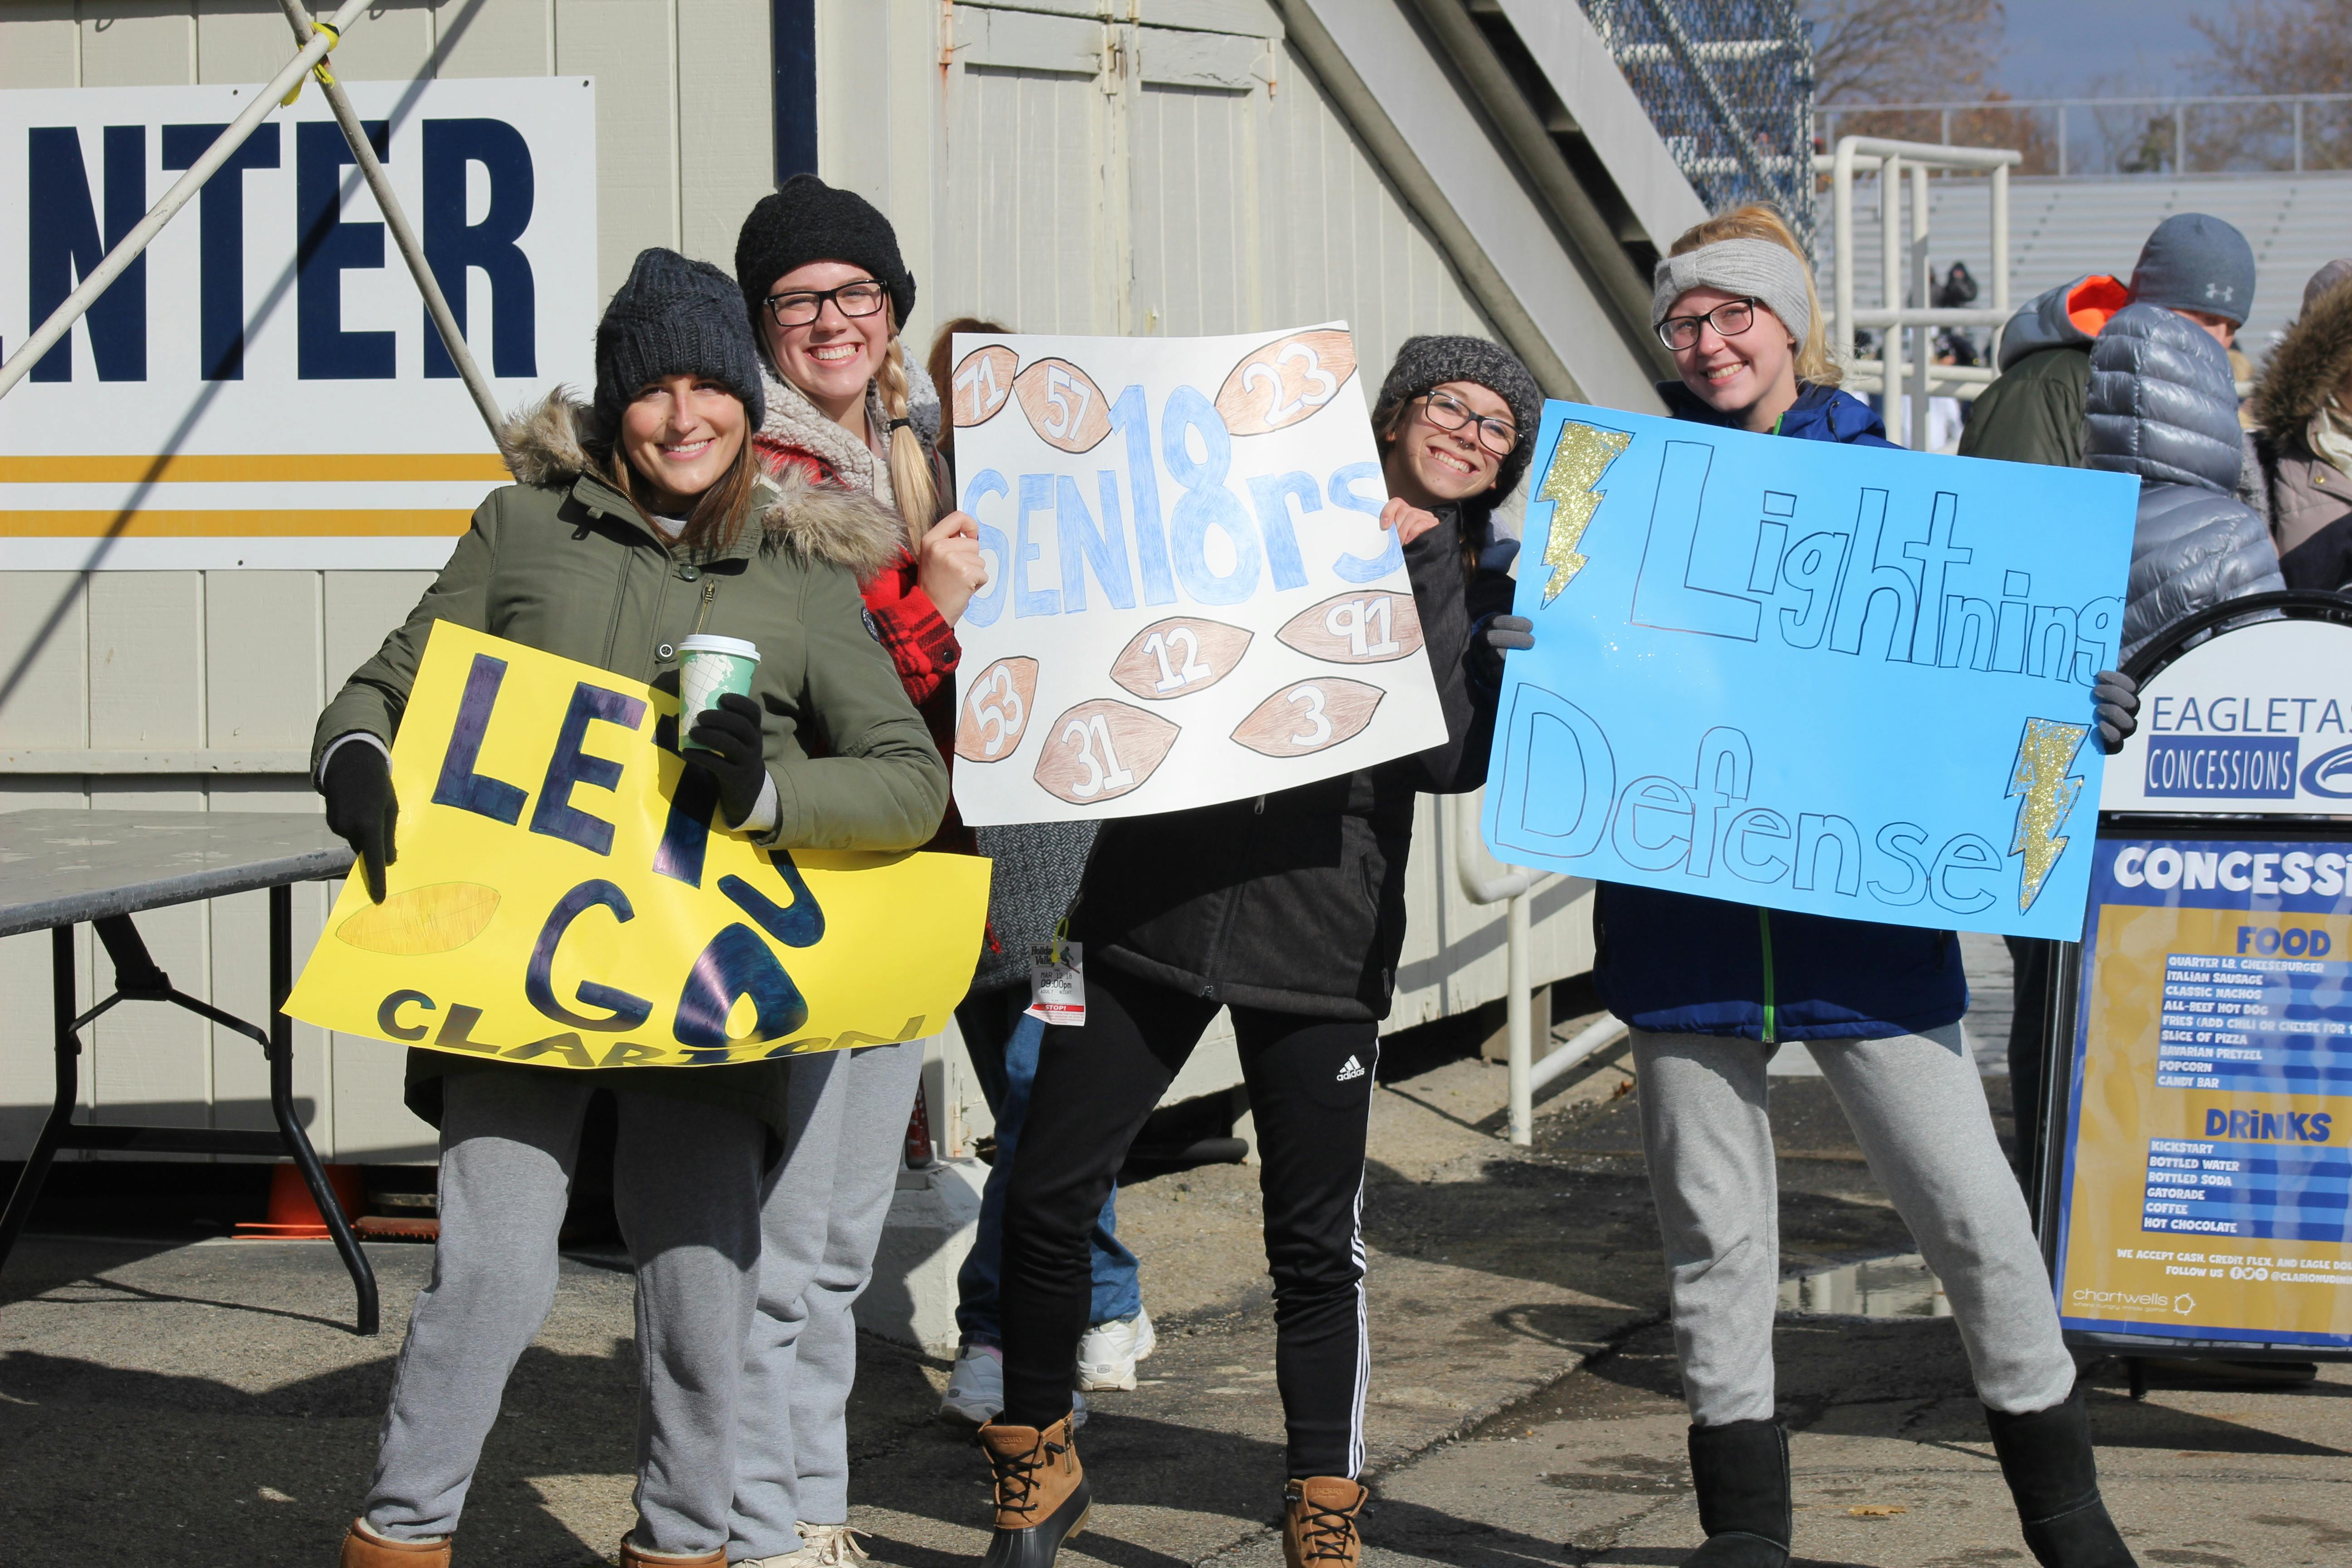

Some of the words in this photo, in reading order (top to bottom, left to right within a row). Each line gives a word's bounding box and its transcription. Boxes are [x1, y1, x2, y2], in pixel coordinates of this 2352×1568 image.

[0, 117, 538, 382] NTER
[955, 353, 1006, 421] 71
[1242, 343, 1338, 427] 23
[1042, 364, 1092, 440] 57
[1631, 440, 2127, 689] Lightning
[1326, 598, 1400, 658] 91
[1141, 626, 1213, 693] 12
[968, 664, 1024, 756] 53
[1286, 684, 1333, 747] 3
[2151, 697, 2352, 734] EAGLETA
[1061, 713, 1136, 798] 31
[2148, 749, 2291, 791] CONCESSIONS
[1494, 682, 2003, 915] Defense
[2237, 926, 2331, 957] FOOD
[524, 878, 809, 1049] GO
[2168, 956, 2219, 969] QUARTER
[2221, 958, 2237, 970] LB.
[2240, 960, 2324, 974] CHEESEBURGER
[2212, 973, 2263, 985] SAUSAGE
[2216, 987, 2262, 1000] NACHOS
[2164, 1000, 2215, 1013] ALL-BEEF
[2217, 1003, 2241, 1014] HOT
[2243, 1004, 2268, 1015] DOG
[2196, 1017, 2223, 1029] (ADD
[2259, 1020, 2276, 1031] OR
[2279, 1021, 2321, 1033] CHEESE
[2323, 1023, 2346, 1034] FOR
[2196, 1032, 2212, 1043] OF
[2216, 1048, 2263, 1061] PRETZEL
[1336, 1067, 1365, 1081] adidas
[2158, 1060, 2213, 1073] POPCORN
[2157, 1075, 2195, 1087] CANDY
[2196, 1077, 2220, 1088] BAR
[2149, 1156, 2199, 1169] BOTTLED
[2202, 1158, 2240, 1172] WATER
[2147, 1171, 2198, 1185] BOTTLED
[2200, 1174, 2232, 1187] SODA
[2146, 1187, 2206, 1201] GATORADE
[2145, 1202, 2188, 1215] COFFEE
[2143, 1216, 2168, 1229] HOT
[2170, 1218, 2238, 1233] CHOCOLATE
[2117, 1249, 2133, 1259] WE
[2136, 1250, 2174, 1261] ACCEPT
[2276, 1258, 2298, 1269] AND
[2300, 1259, 2331, 1270] EAGLE
[2165, 1265, 2207, 1278] FOLLOW
[2209, 1269, 2224, 1278] US
[2073, 1288, 2169, 1306] chartwells
